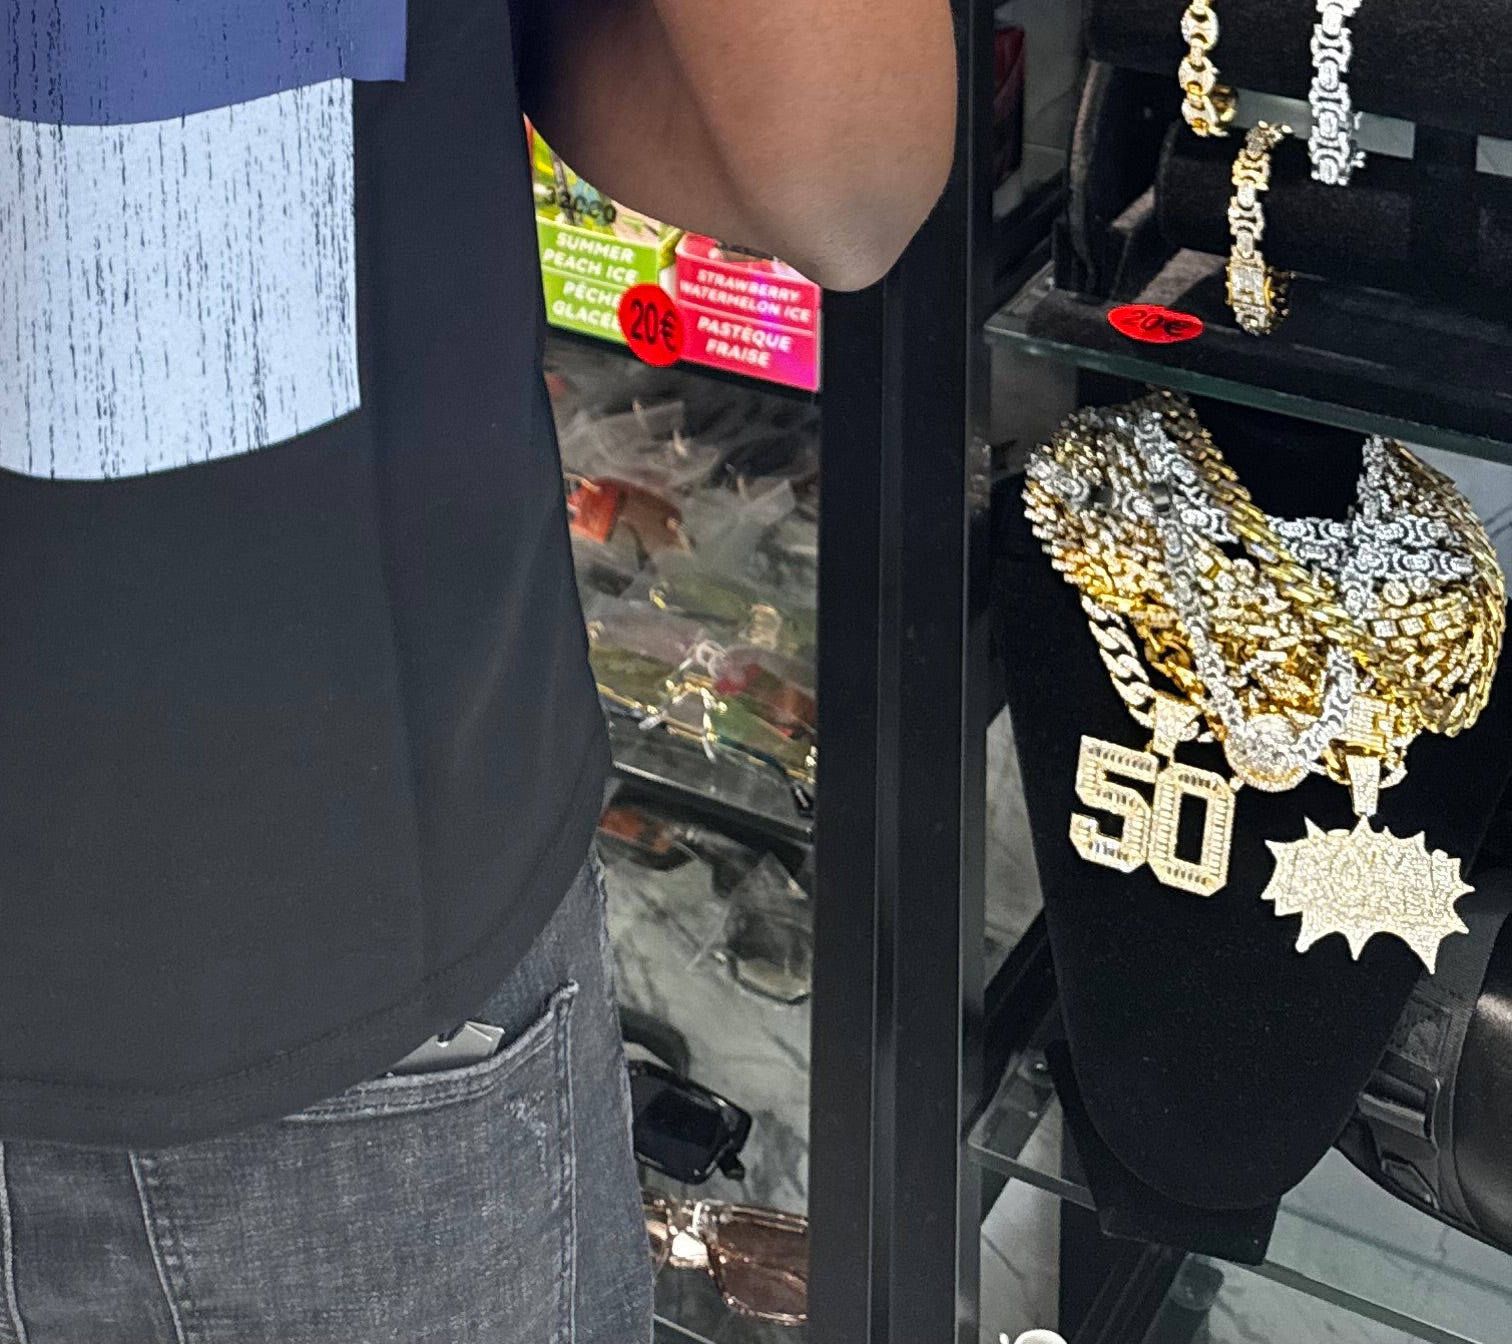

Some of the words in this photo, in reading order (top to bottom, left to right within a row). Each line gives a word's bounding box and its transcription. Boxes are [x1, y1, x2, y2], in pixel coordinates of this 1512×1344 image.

[556, 231, 635, 263] SUMMER
[543, 248, 602, 276] PEACH
[606, 265, 638, 286] ICE
[679, 279, 781, 316] WATERMELON
[783, 306, 811, 323] ICE
[697, 269, 801, 302] STRAWBERRY
[631, 298, 677, 353] 20€
[1121, 310, 1194, 337] 20€
[705, 338, 771, 368] FRAISE
[1069, 735, 1236, 897] 50
